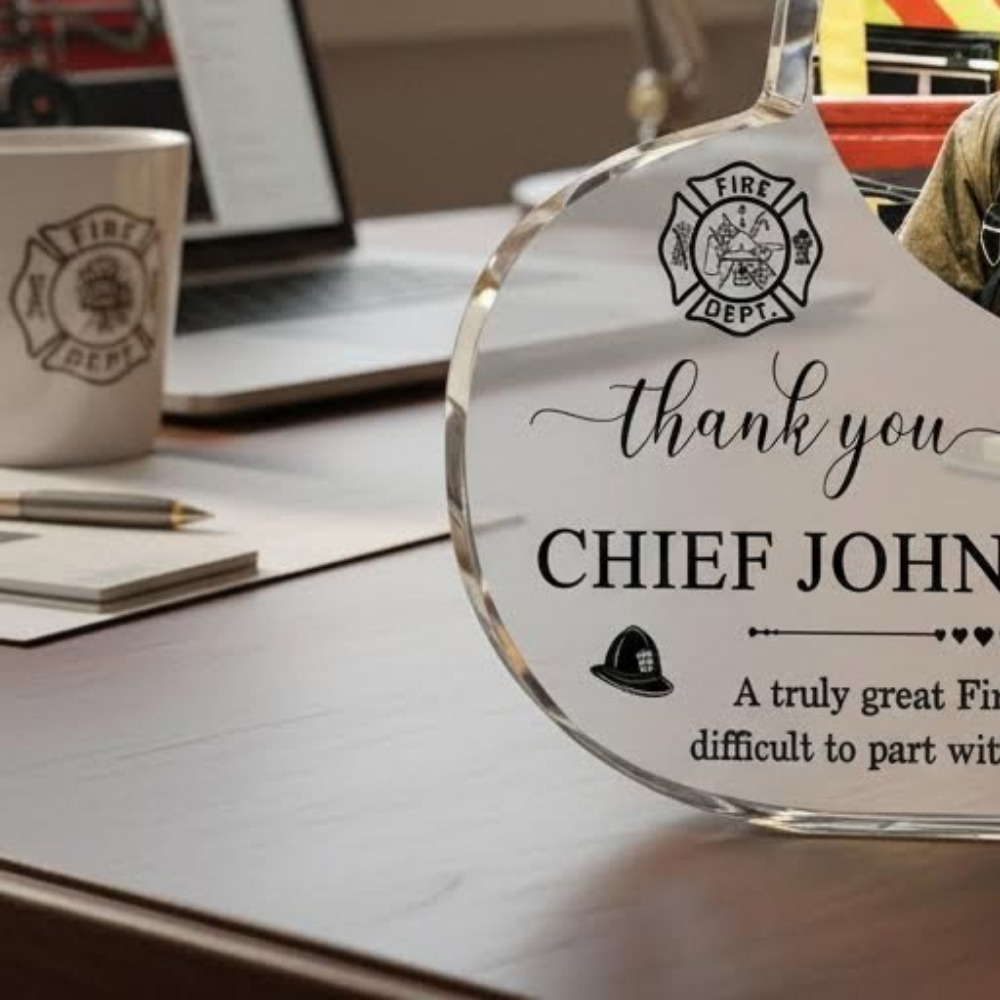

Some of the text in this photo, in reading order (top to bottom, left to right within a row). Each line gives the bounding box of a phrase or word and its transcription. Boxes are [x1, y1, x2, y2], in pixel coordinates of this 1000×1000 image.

[715, 175, 771, 198] FIRE
[704, 298, 777, 323] DEPT.
[530, 351, 828, 459] thank
[537, 528, 774, 591] CHIEF
[733, 677, 761, 707] A
[770, 677, 850, 716] truly
[861, 681, 946, 717] great
[690, 728, 815, 763] difficult
[824, 733, 856, 763] to
[868, 736, 937, 771] part
